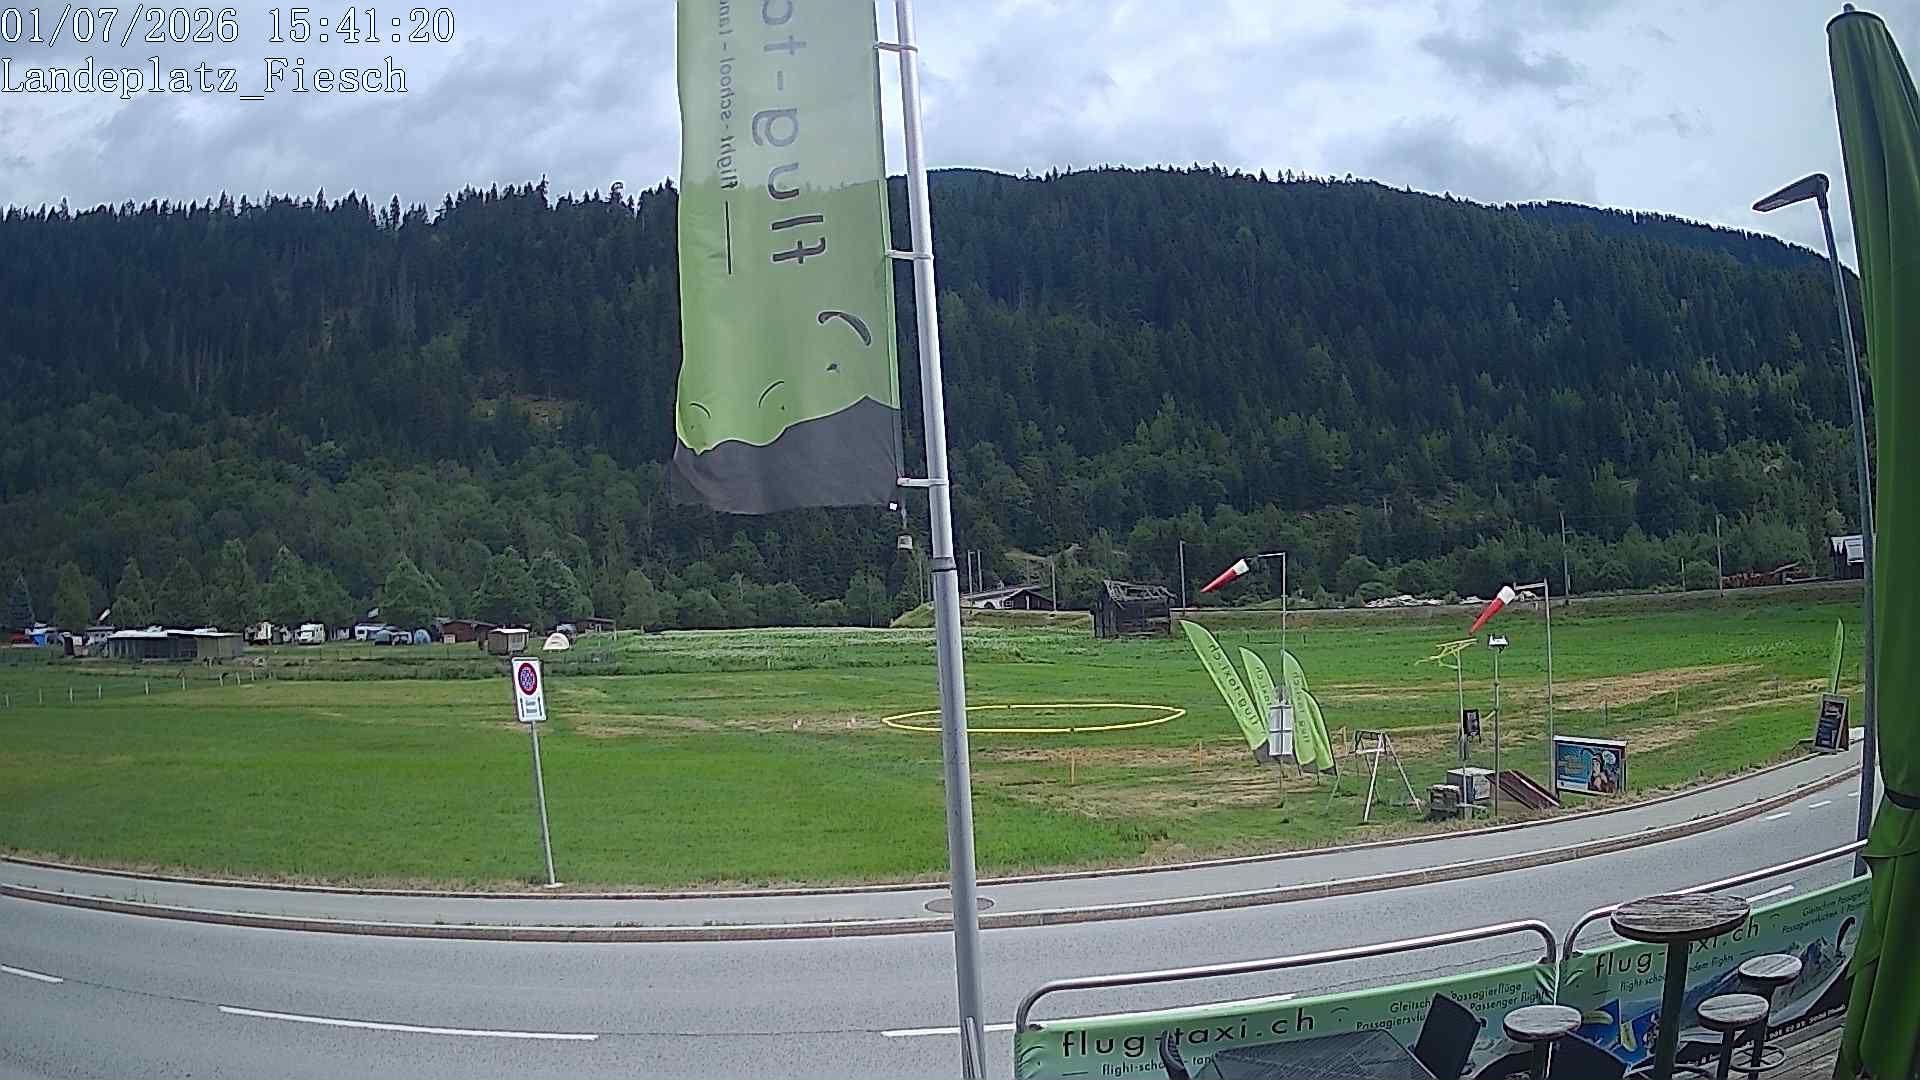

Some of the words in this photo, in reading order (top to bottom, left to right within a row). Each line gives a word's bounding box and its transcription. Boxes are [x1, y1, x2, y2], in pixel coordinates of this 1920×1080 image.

[1390, 998, 1432, 1014] Gleitsch
[1356, 1011, 1426, 1031] Passagiersvlu
[1062, 1007, 1315, 1059] flug-taxi.ch
